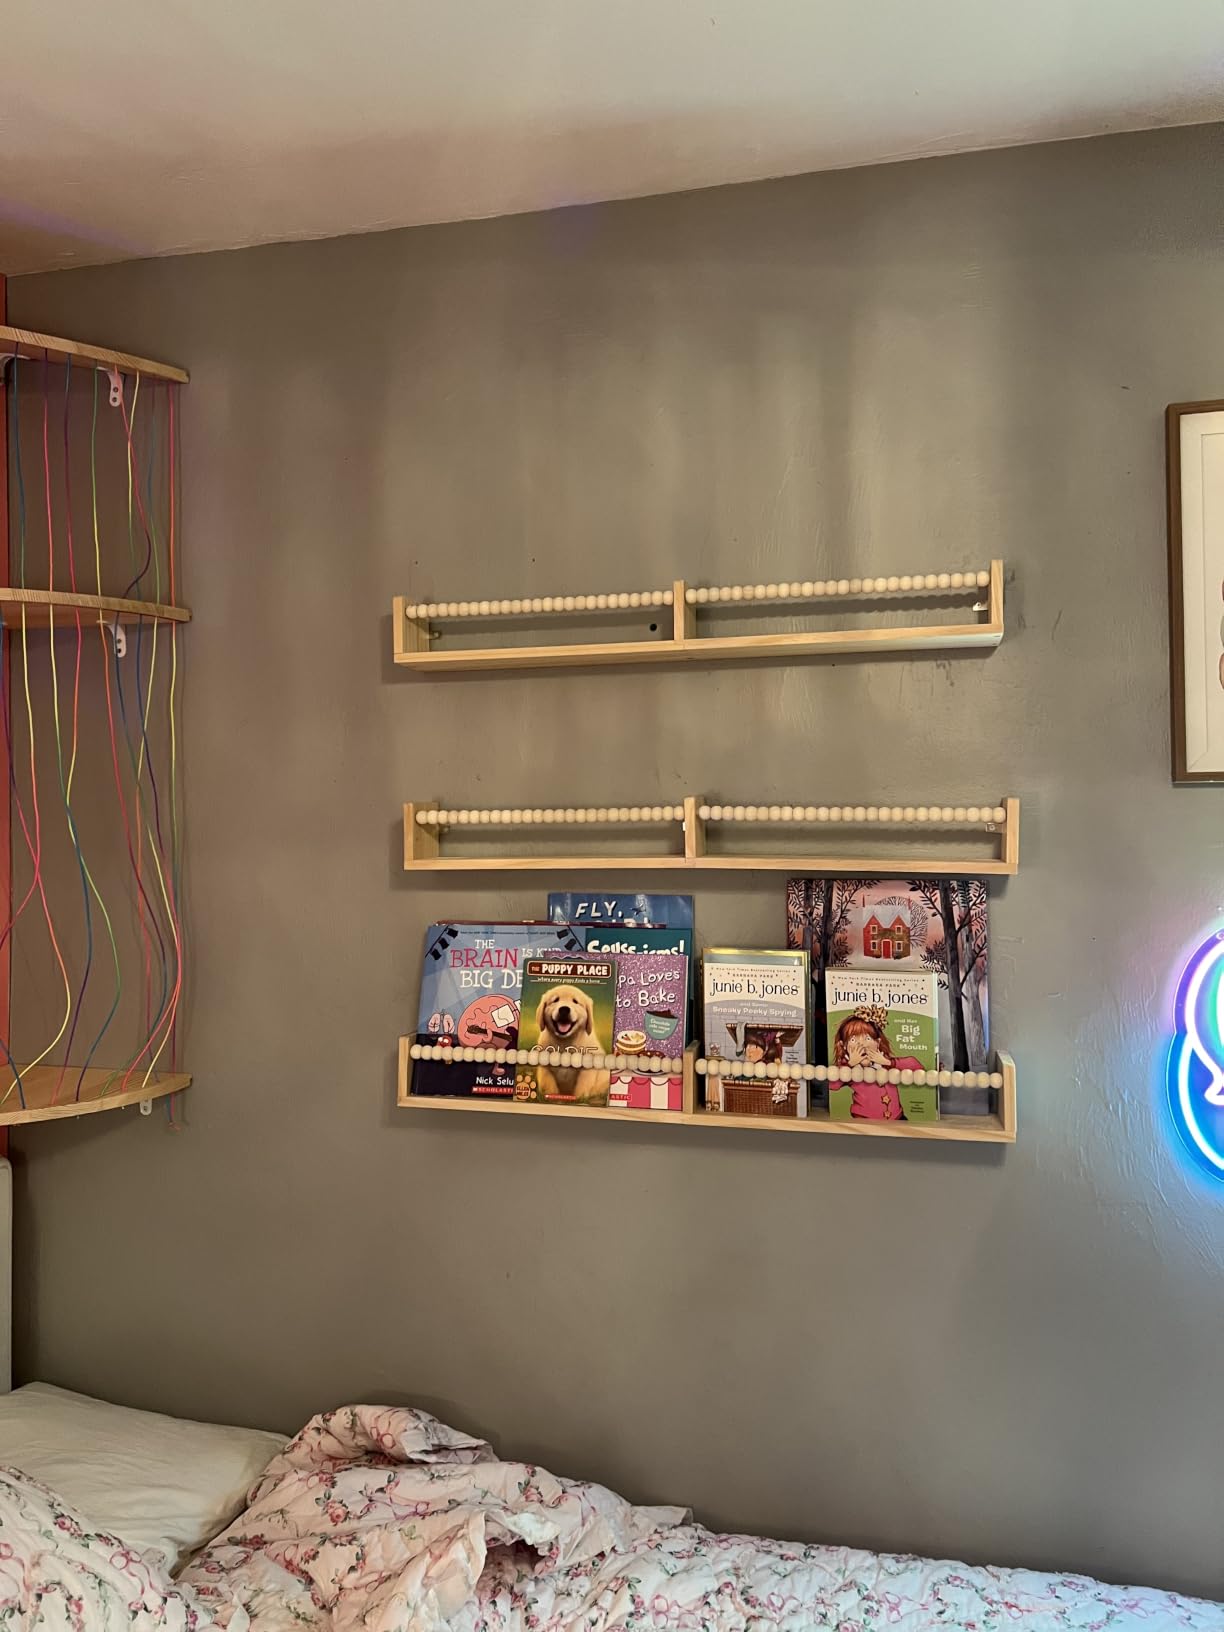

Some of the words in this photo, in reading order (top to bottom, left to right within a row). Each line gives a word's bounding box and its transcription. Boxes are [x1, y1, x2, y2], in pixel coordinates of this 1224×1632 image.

[575, 900, 623, 918] FLY,
[474, 939, 495, 949] THE
[450, 948, 519, 968] BRAIN
[521, 948, 533, 957] IS
[541, 963, 573, 974] PUPPY
[577, 965, 608, 976] PLACE
[460, 969, 494, 988] BIG
[640, 970, 681, 986] Loves
[709, 978, 742, 996] junie
[747, 979, 758, 994] b.
[759, 980, 799, 998] jones
[616, 995, 631, 1008] to
[638, 986, 676, 1007] Bake
[832, 987, 867, 1005] junie
[872, 988, 884, 1003] b.
[885, 989, 928, 1007] jones
[712, 1006, 741, 1015] Sneaky
[769, 1008, 797, 1017] Spying
[896, 1034, 915, 1042] Fat
[901, 1024, 920, 1036] Big
[475, 1076, 494, 1085] Nick
